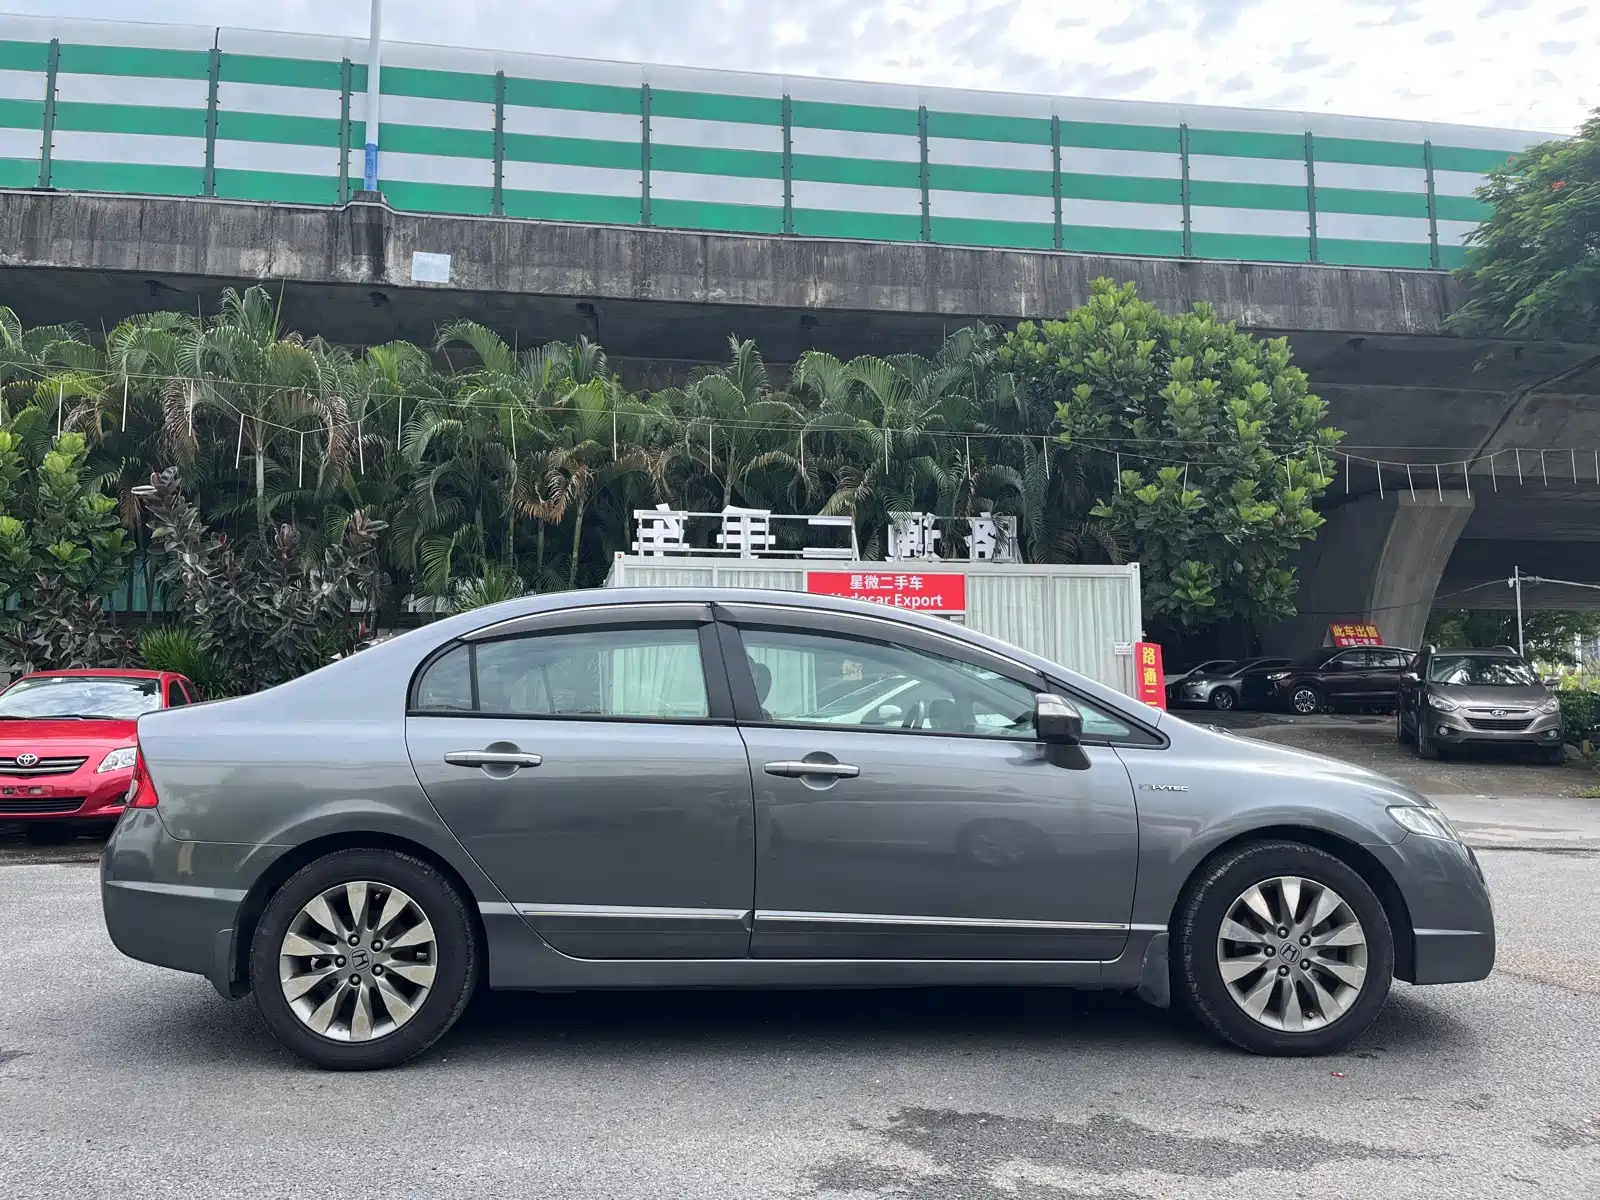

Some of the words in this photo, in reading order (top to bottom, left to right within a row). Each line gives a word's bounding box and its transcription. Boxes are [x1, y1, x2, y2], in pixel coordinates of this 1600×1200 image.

[850, 575, 924, 591] 星微二手车
[894, 594, 943, 608] Export
[1142, 647, 1158, 705] 路通二
